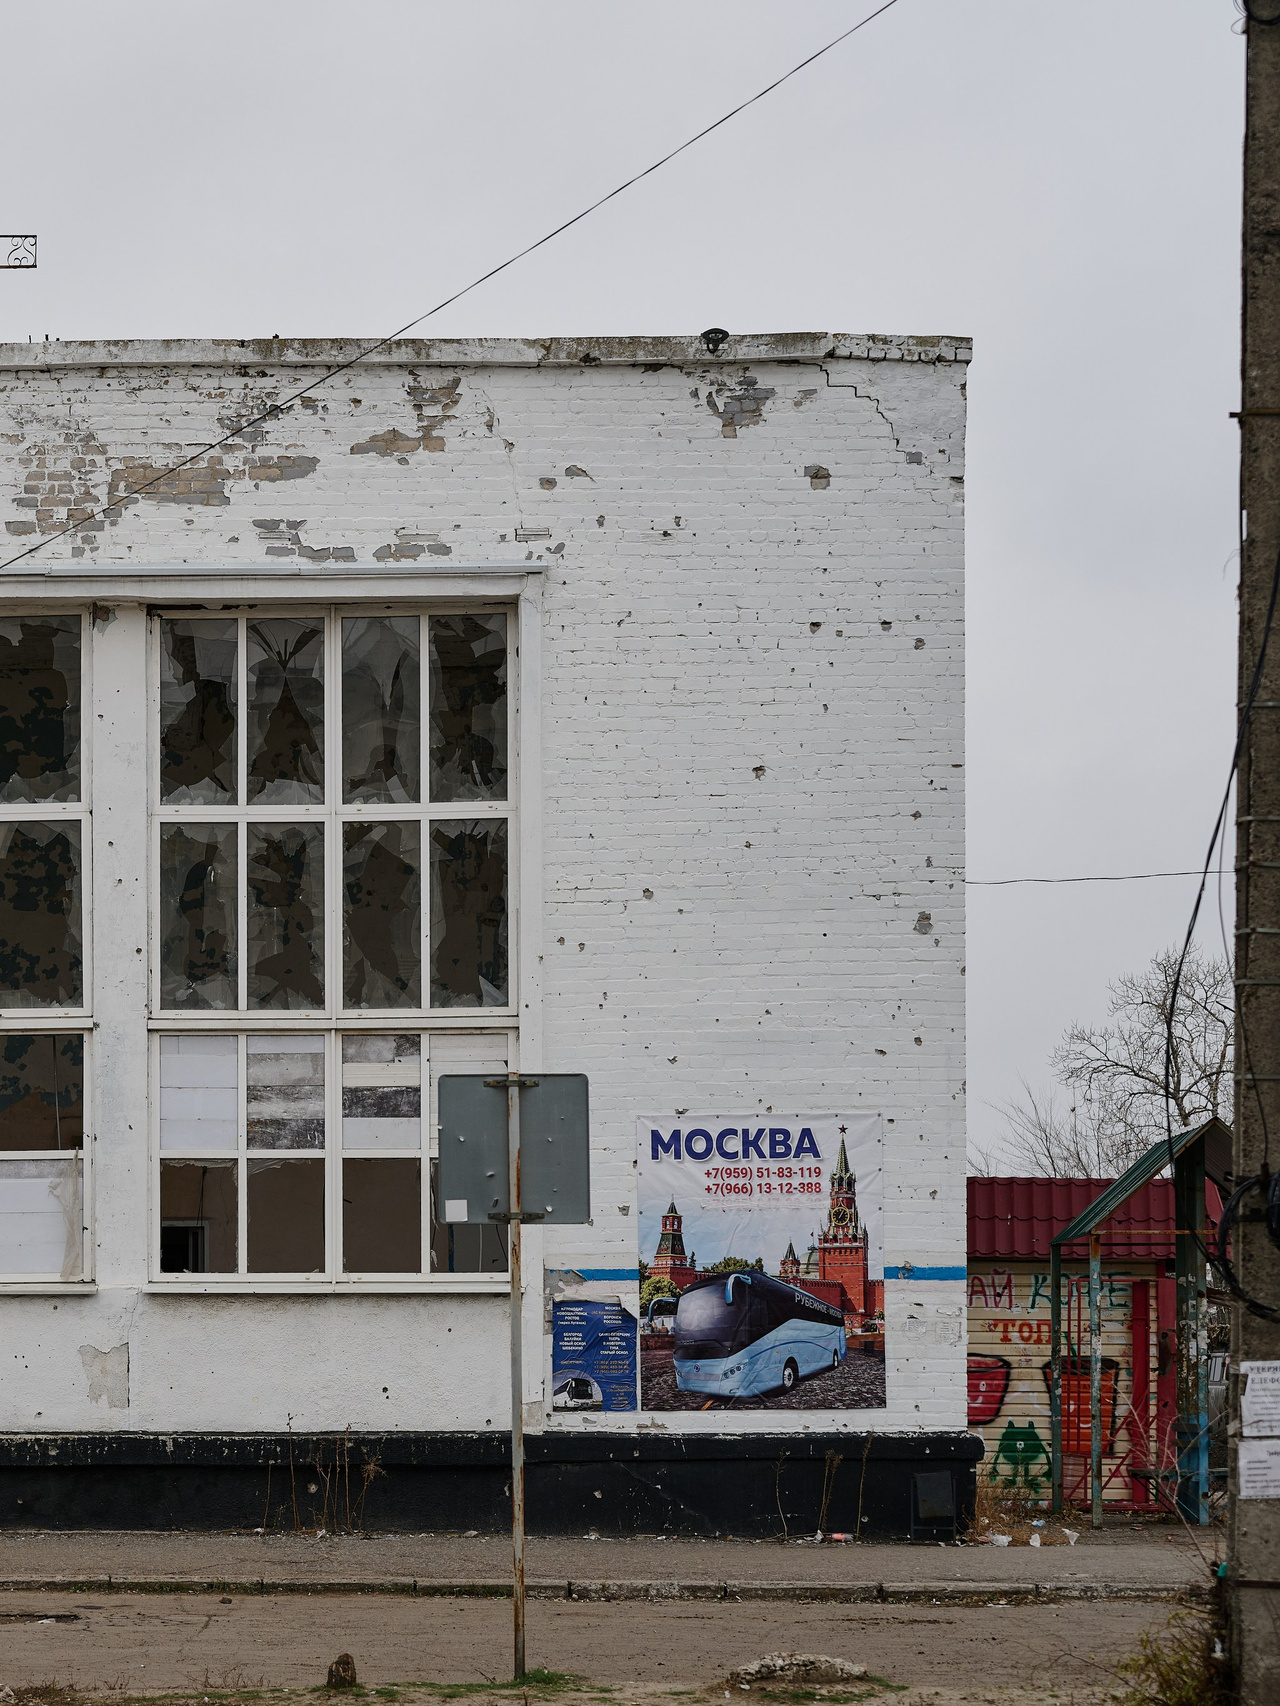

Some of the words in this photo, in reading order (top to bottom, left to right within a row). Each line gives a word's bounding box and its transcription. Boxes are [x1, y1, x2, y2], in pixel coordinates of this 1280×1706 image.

[650, 1127, 822, 1161] МОСКВА
[704, 1166, 753, 1181] +7(959)
[756, 1166, 822, 1180] 51-83-119
[704, 1182, 753, 1197] +7(966)
[757, 1182, 822, 1195] 13-12-388
[969, 1268, 1013, 1310] АЙ
[1249, 1365, 1280, 1373] УТЕРЯ
[1250, 1376, 1280, 1384] ЕЛЕФ
